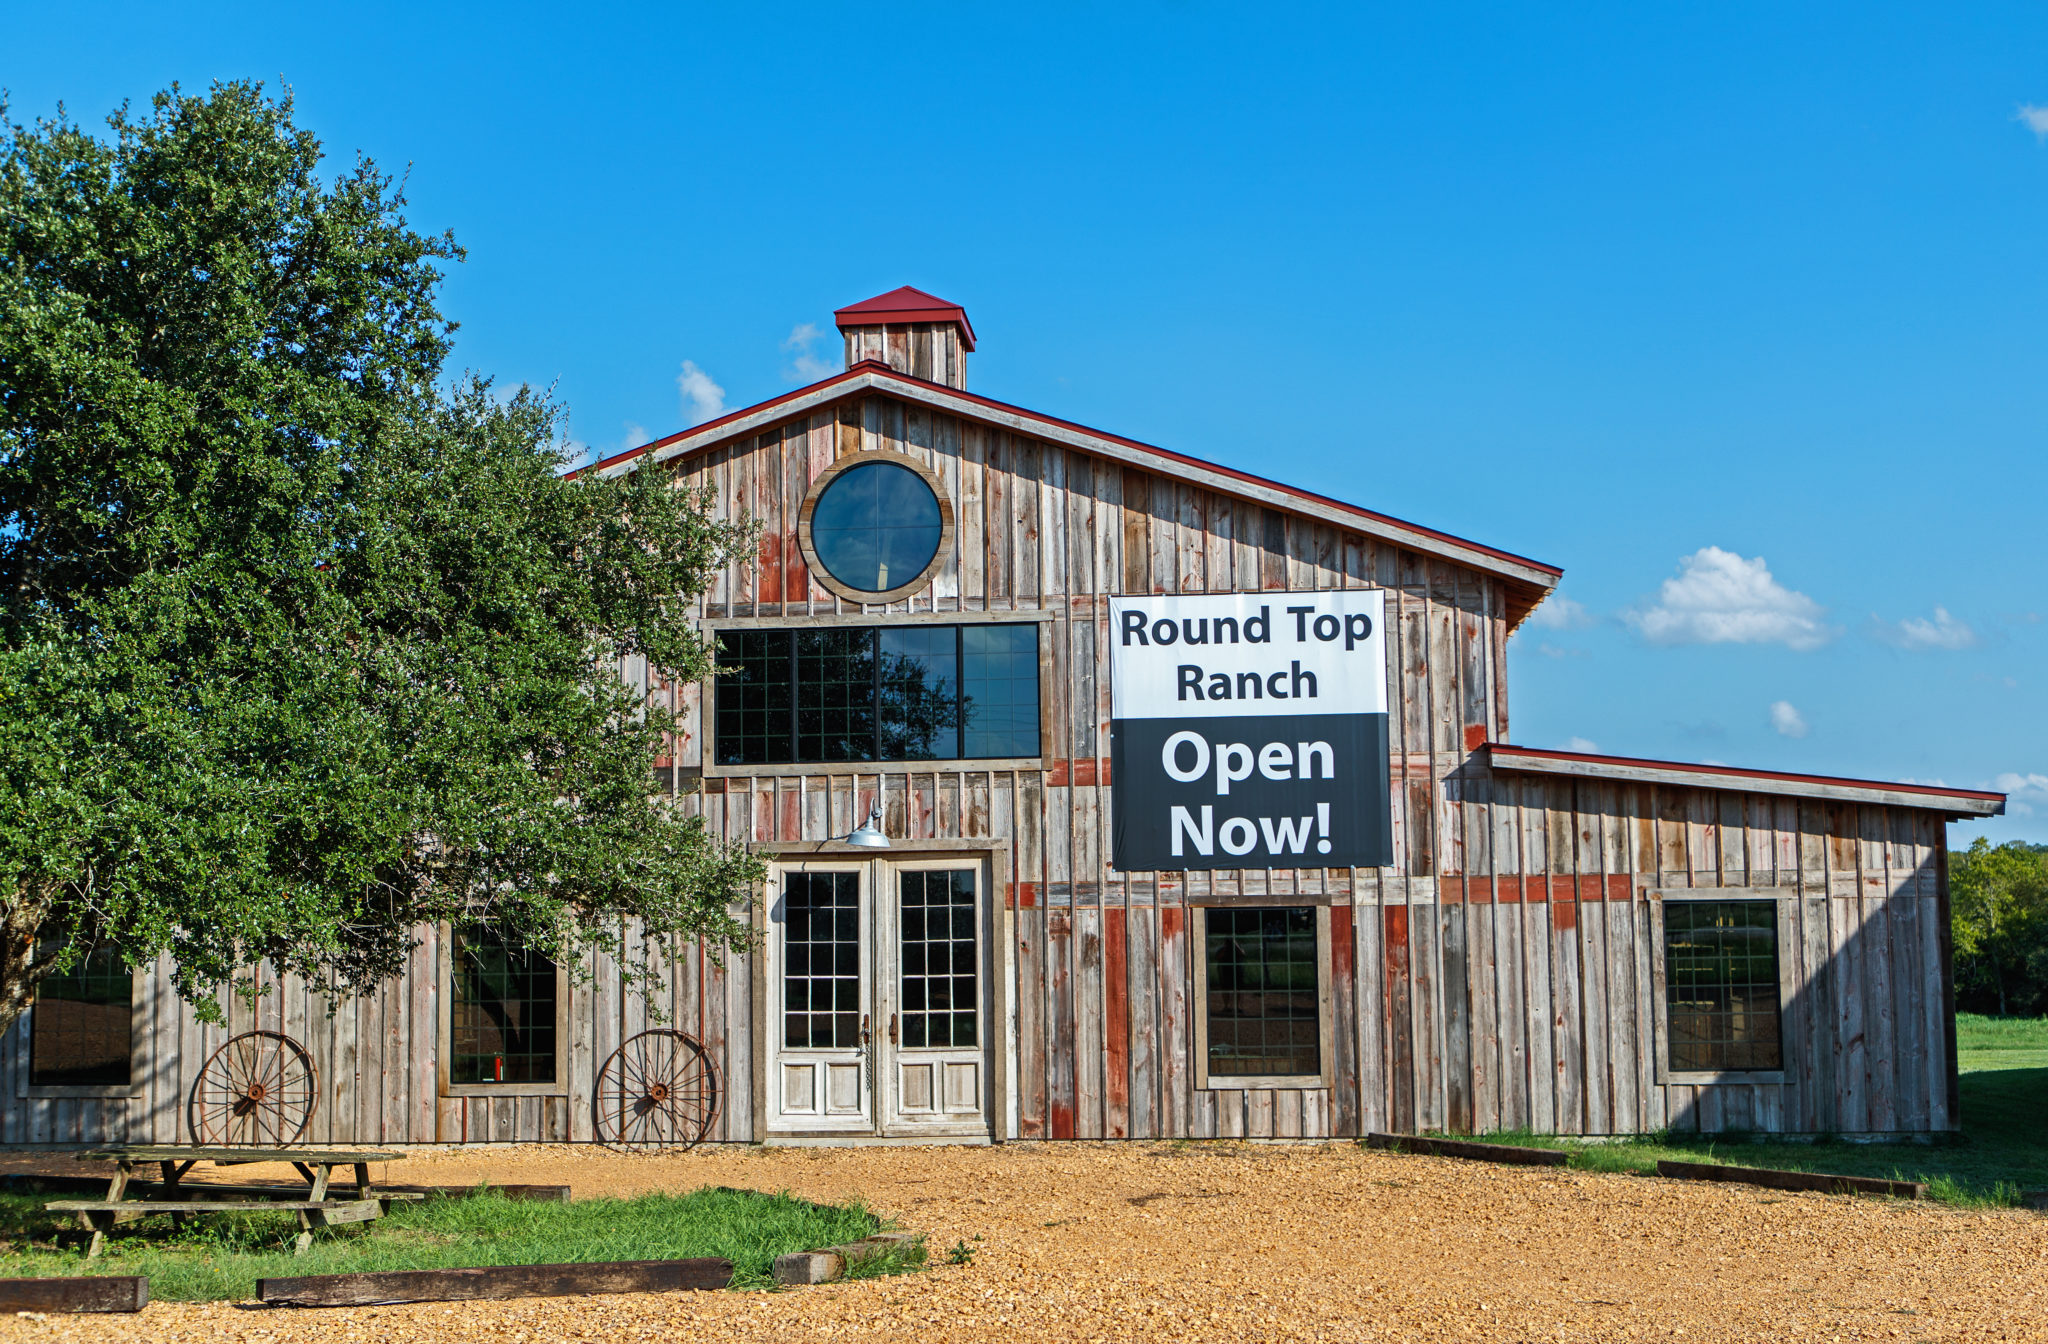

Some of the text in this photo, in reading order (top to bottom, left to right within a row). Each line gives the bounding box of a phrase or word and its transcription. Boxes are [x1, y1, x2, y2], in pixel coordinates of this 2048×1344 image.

[1121, 605, 1373, 651] Round Top
[1177, 661, 1318, 701] Ranch
[1161, 730, 1335, 796] Open
[1170, 803, 1332, 857] Now!
